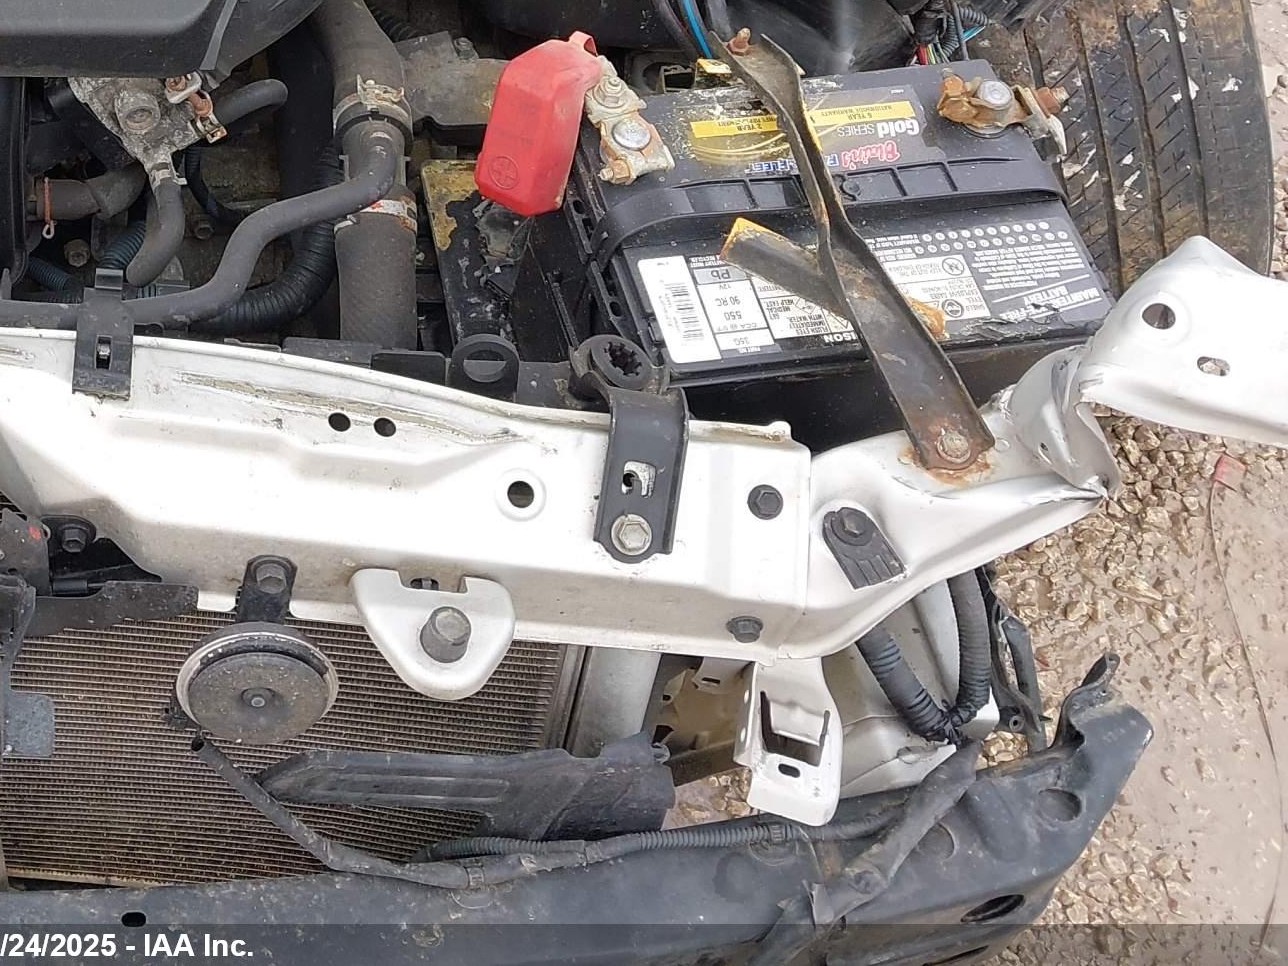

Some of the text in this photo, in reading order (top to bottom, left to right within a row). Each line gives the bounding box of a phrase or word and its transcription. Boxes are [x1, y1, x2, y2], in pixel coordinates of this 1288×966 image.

[838, 118, 920, 139] Gold SERIES
[842, 140, 900, 169] Blain's
[748, 160, 788, 172] FLEET
[711, 269, 731, 280] Pb
[1024, 286, 1068, 304] BATTERY
[715, 296, 741, 306] 90 RC
[780, 298, 795, 306] HELP
[766, 305, 791, 313] MEDICAL
[724, 311, 742, 321] 550
[808, 313, 823, 321] WITH
[789, 320, 825, 329] IMMEDIATELY
[795, 326, 828, 335] FLUSH EYES
[822, 331, 856, 343] ISON
